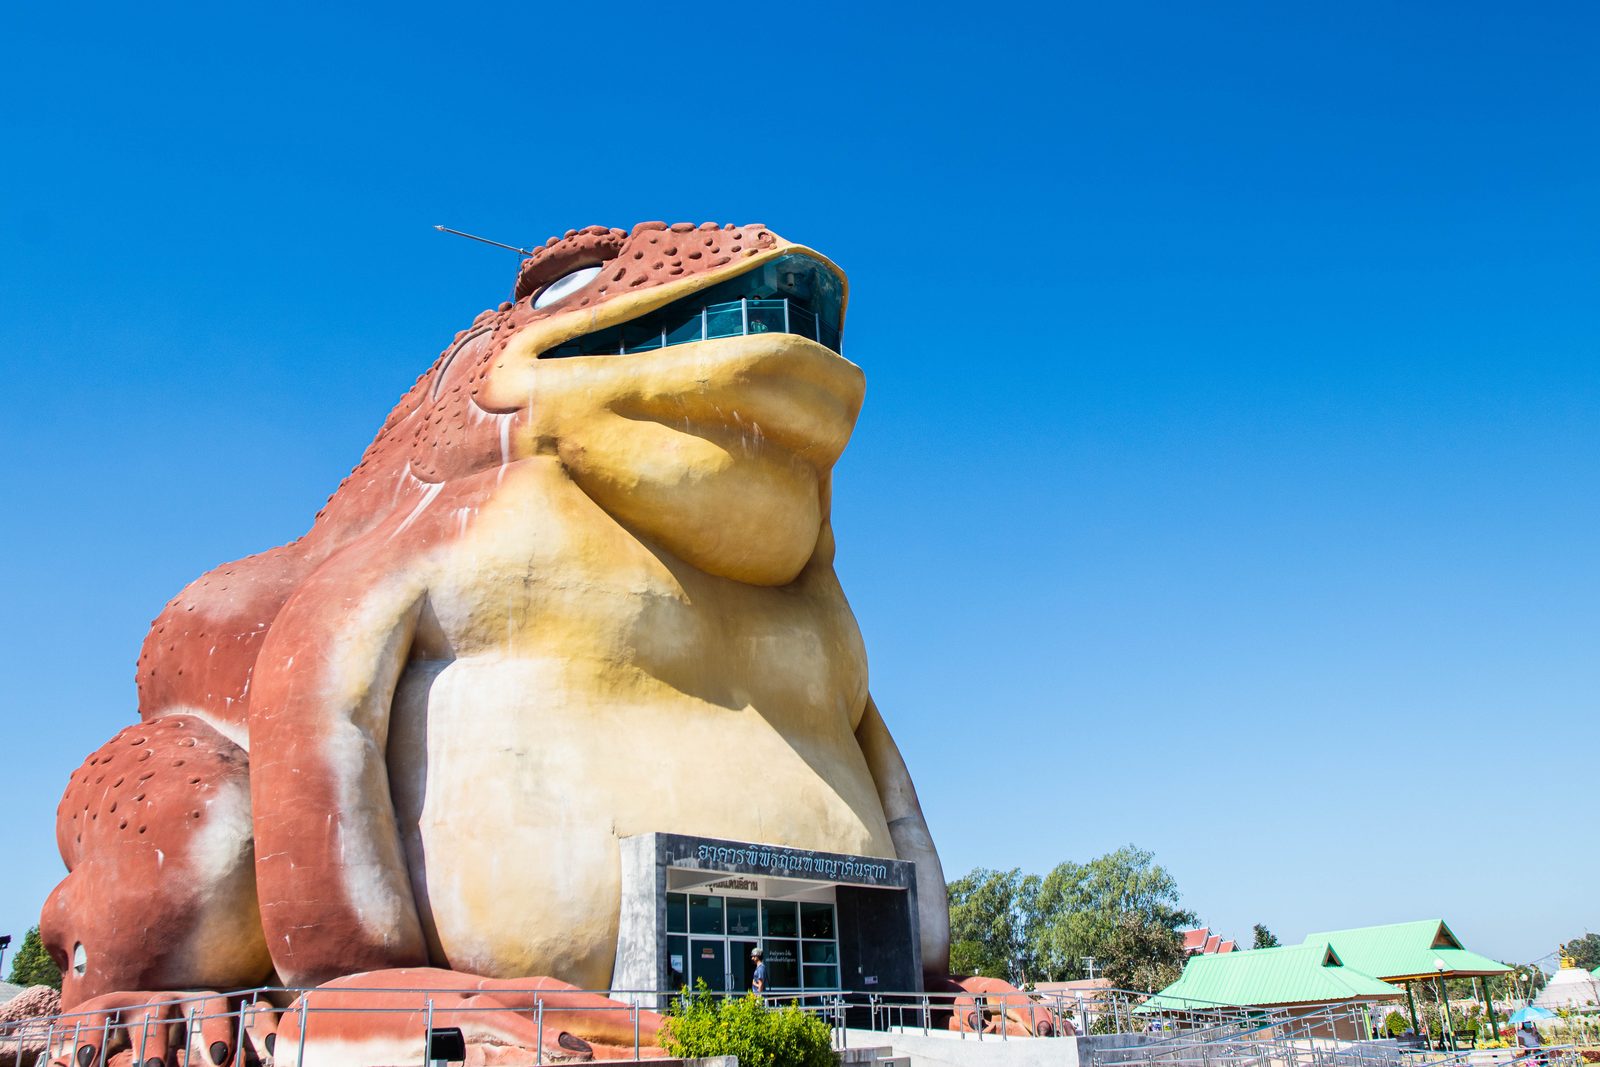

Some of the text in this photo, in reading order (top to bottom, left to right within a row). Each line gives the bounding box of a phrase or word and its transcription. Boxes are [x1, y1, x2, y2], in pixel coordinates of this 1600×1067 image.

[698, 844, 887, 879] อาคารพิพิธภัณฑ์พญาคันคาก
